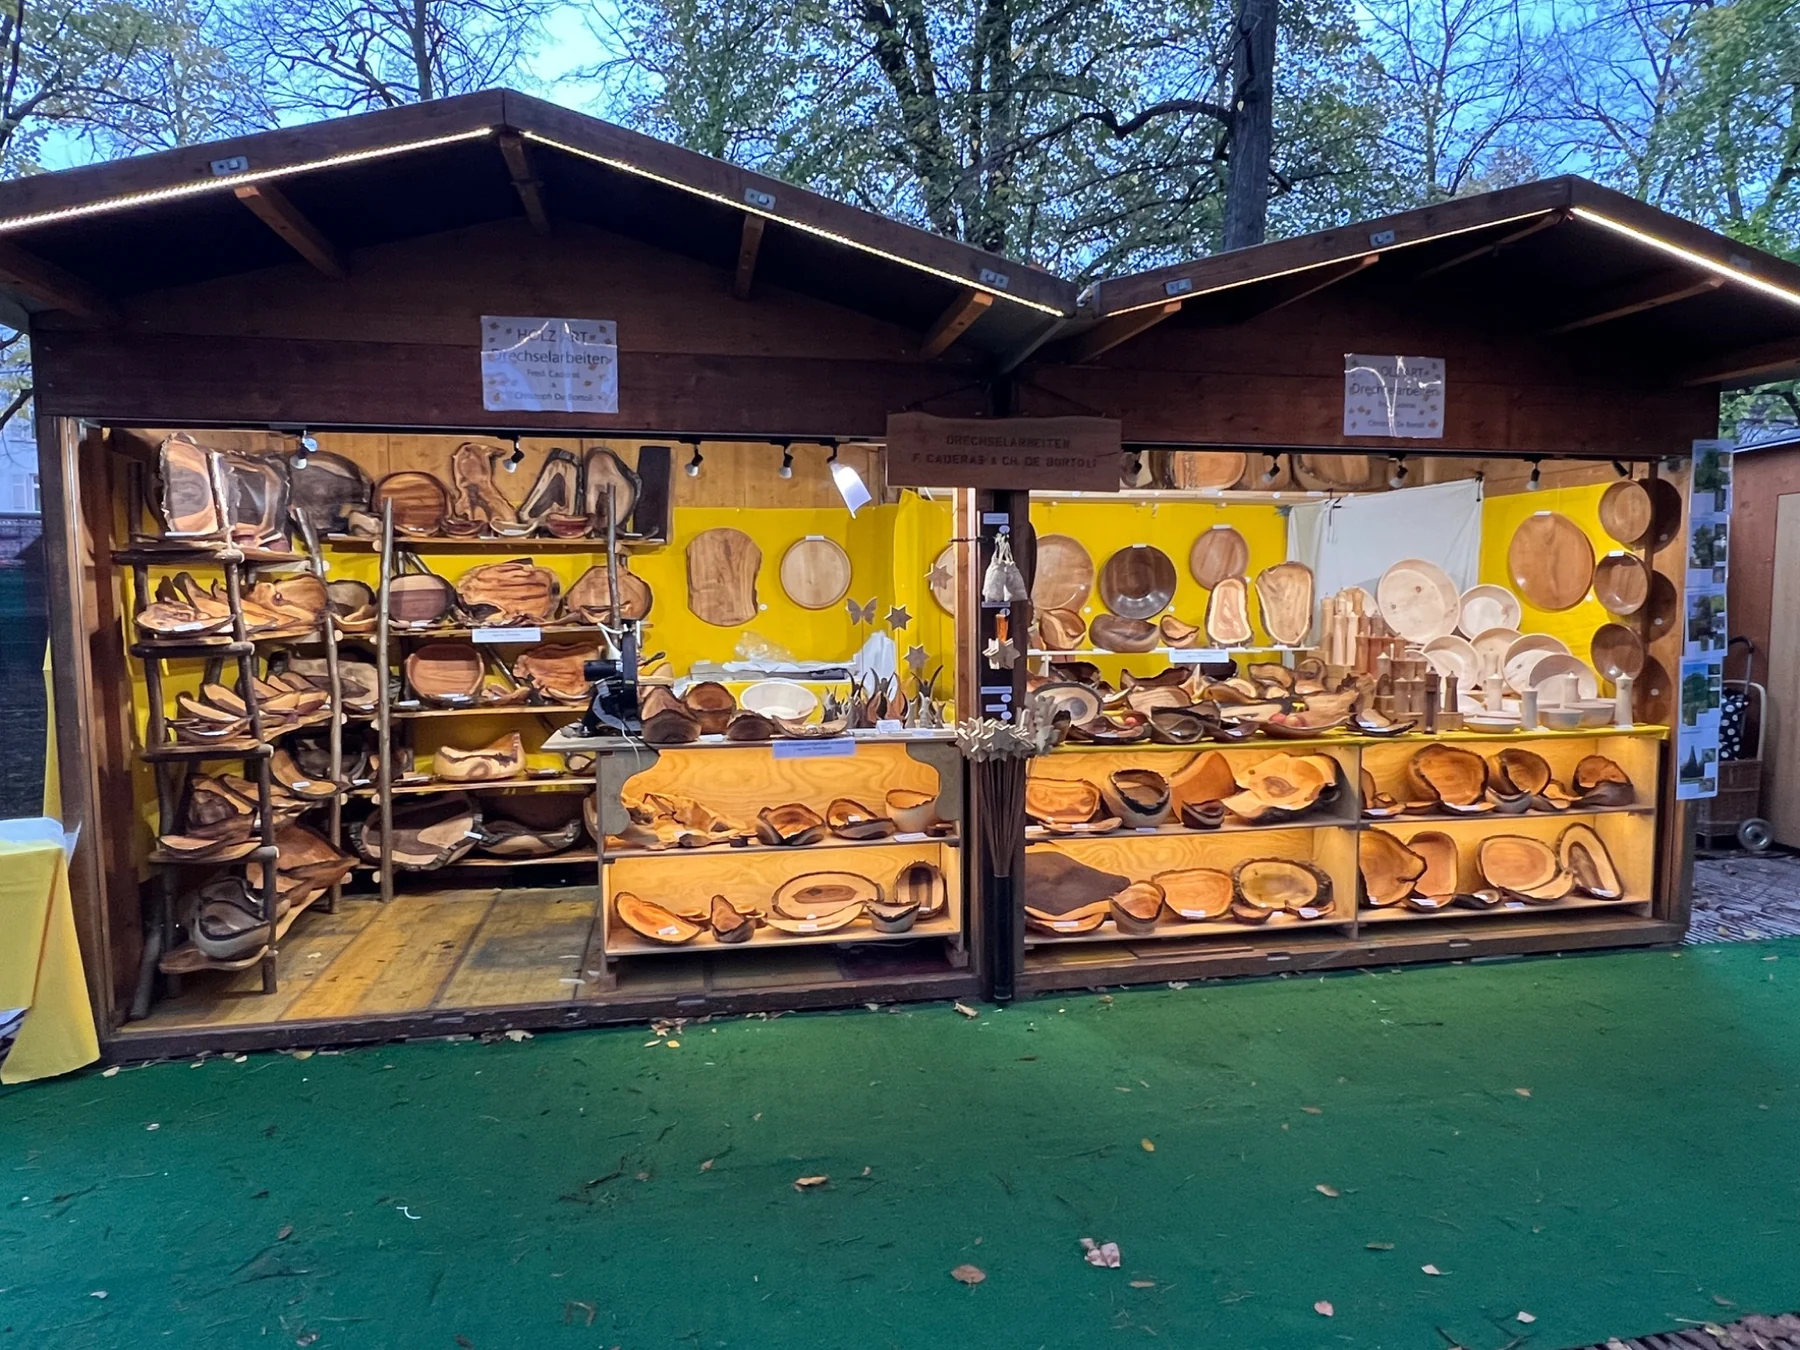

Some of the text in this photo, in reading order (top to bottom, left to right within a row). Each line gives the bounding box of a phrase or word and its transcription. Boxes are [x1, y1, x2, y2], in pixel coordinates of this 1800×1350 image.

[1351, 383, 1439, 397] Drechearbeen
[946, 434, 1071, 450] DRECHSELARBEITEN
[926, 453, 985, 466] CADERAS
[1024, 456, 1041, 467] DE
